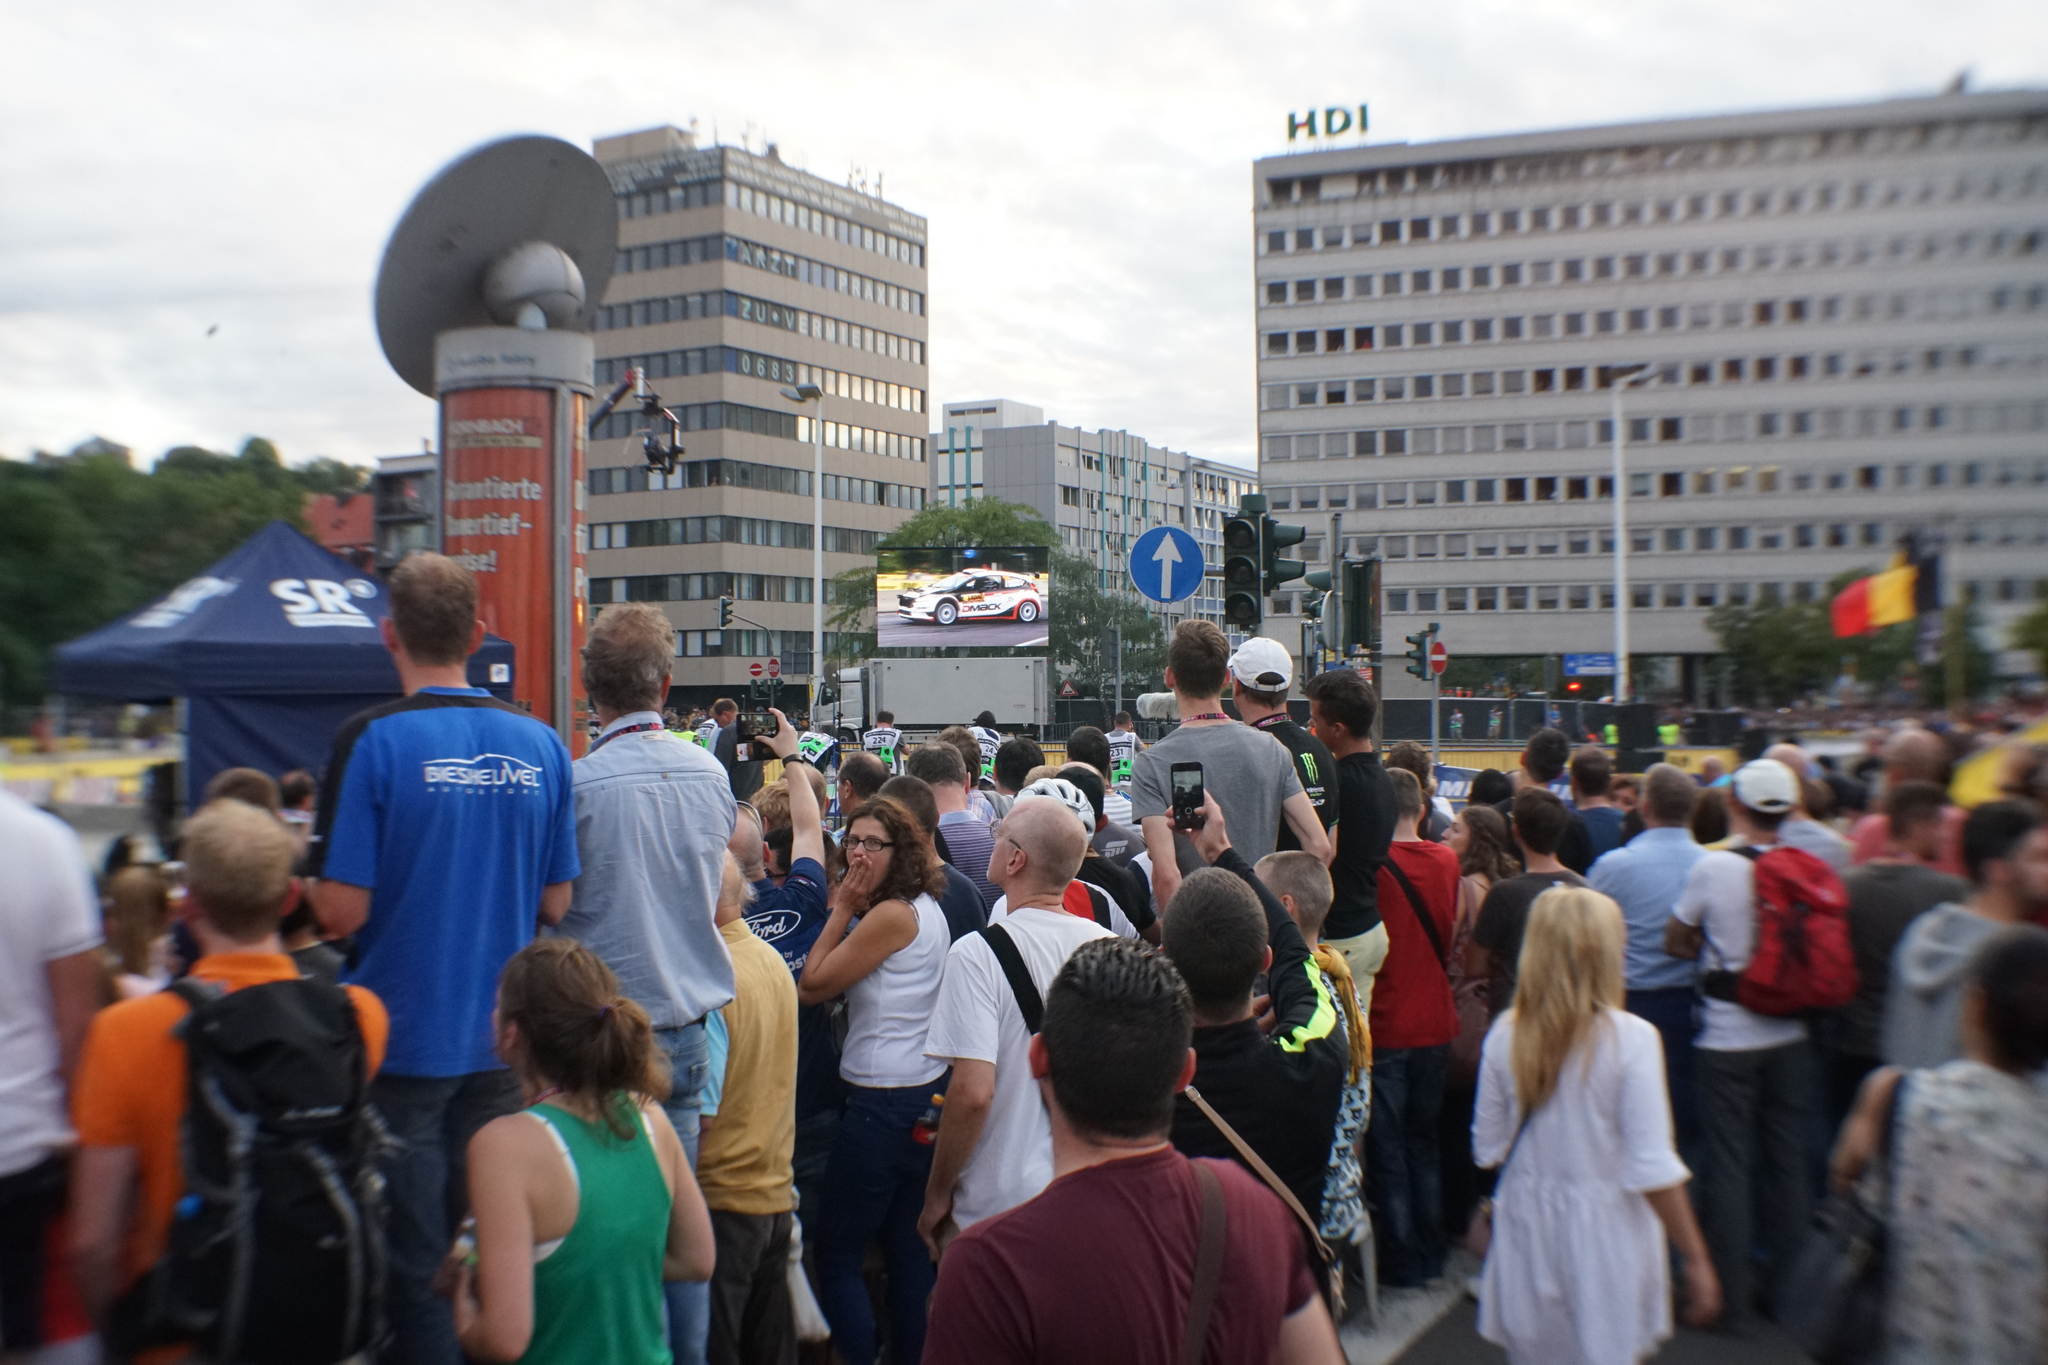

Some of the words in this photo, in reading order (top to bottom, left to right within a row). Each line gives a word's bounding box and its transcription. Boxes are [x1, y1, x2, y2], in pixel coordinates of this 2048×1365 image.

[1288, 104, 1367, 140] HDI
[740, 243, 796, 277] ARZT
[270, 579, 363, 614] SR
[873, 736, 886, 744] 224
[746, 916, 787, 938] Ford
